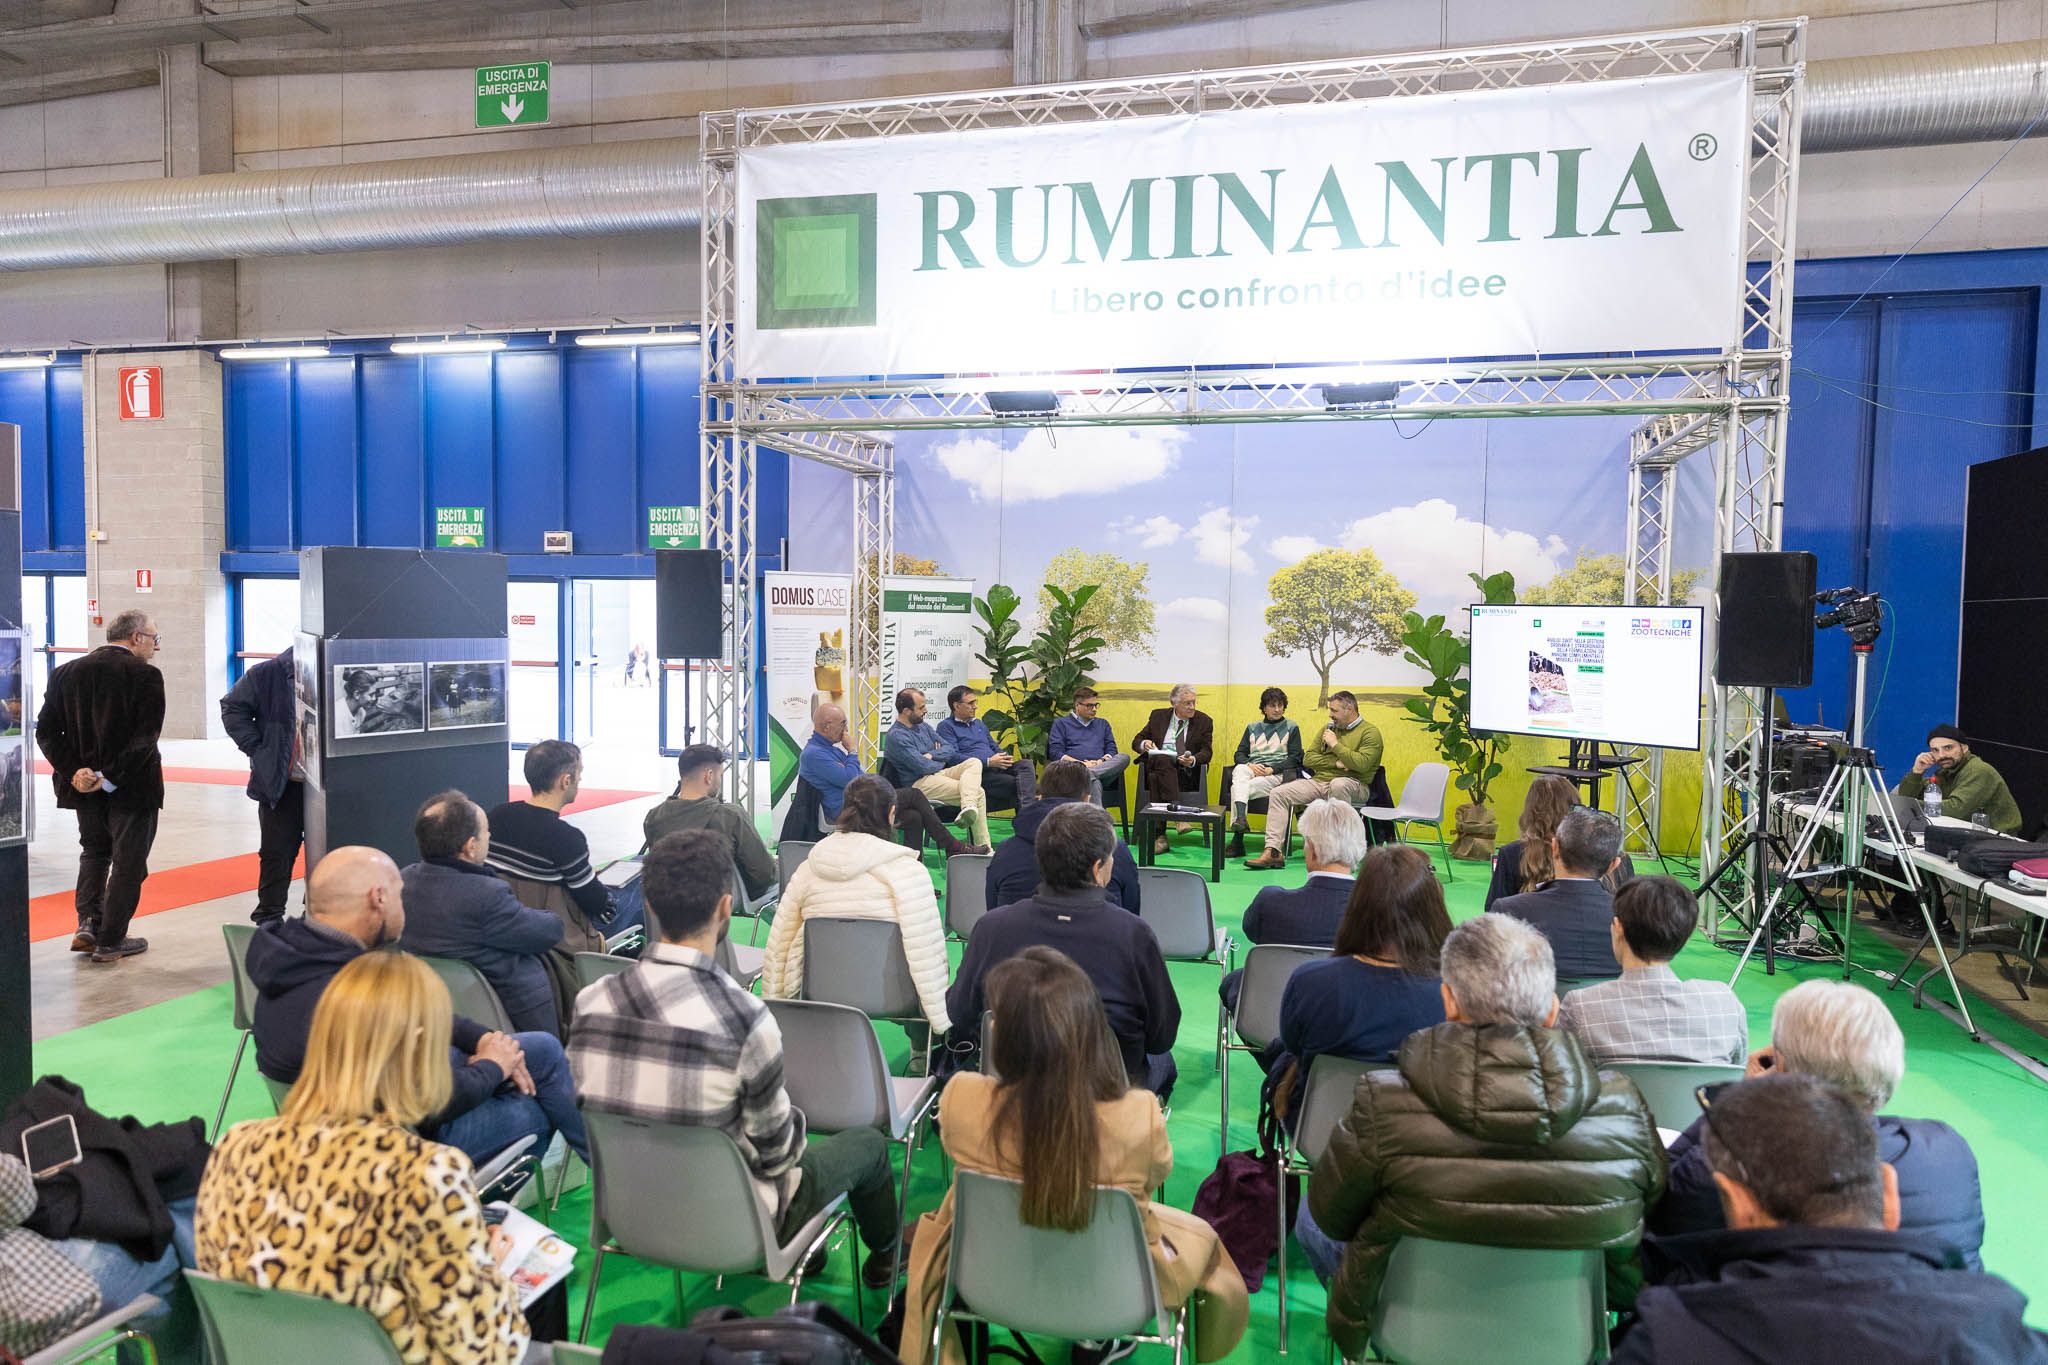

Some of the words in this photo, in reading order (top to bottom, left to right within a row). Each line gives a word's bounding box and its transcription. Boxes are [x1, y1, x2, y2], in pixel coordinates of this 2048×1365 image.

[485, 68, 525, 82] USCITA
[528, 67, 539, 79] DI
[478, 80, 548, 96] EMERGENZA
[913, 142, 1684, 271] RUMINANTIA
[1051, 287, 1165, 316] Libero
[1177, 278, 1366, 310] confronto
[1380, 270, 1506, 300] d'idee
[437, 509, 467, 522] USCITA
[474, 509, 483, 522] DI
[650, 508, 682, 522] USCITA
[689, 508, 699, 521] DI
[437, 523, 483, 536] EMERGENZA
[650, 522, 699, 536] EMERGENZA
[771, 587, 814, 605] DOMUS
[817, 588, 847, 607] CASEI
[1631, 628, 1692, 637] ZOOTECNICHE
[930, 637, 963, 647] nutrizione
[916, 651, 937, 662] sanità
[881, 622, 896, 726] RUMINANTIA
[905, 681, 948, 691] management
